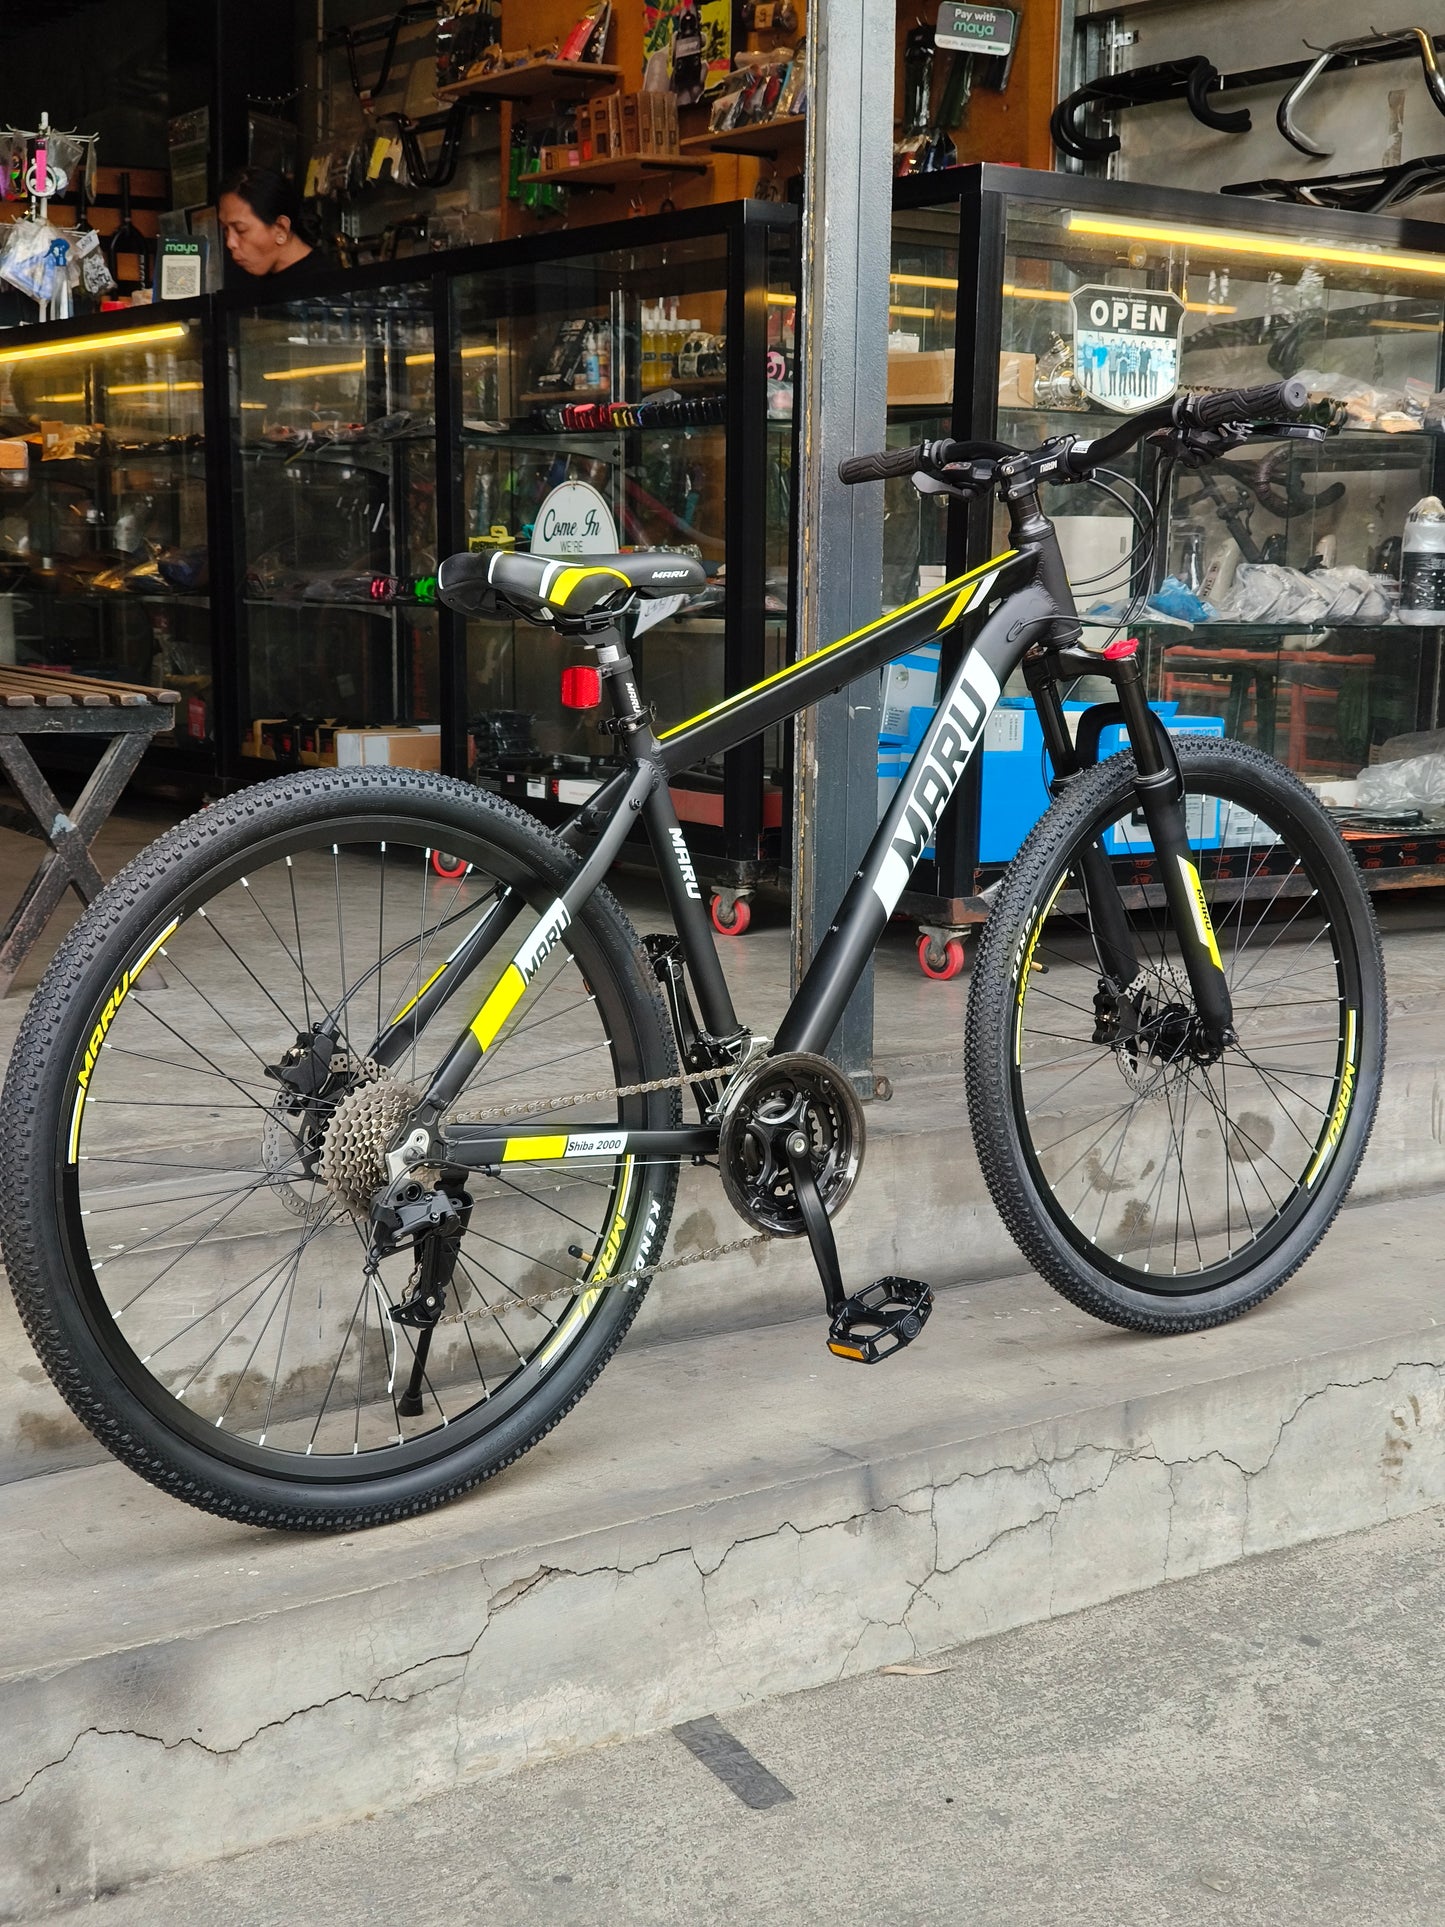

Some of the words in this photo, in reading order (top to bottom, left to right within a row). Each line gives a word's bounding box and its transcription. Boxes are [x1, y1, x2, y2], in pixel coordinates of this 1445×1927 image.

[953, 21, 995, 37] maya
[955, 8, 972, 21] Pay
[974, 12, 996, 22] with
[165, 243, 199, 254] maya
[1090, 300, 1168, 332] OPEN
[543, 508, 578, 542] Come
[581, 508, 602, 537] In
[560, 540, 584, 553] WE'RE
[651, 569, 690, 579] MARU
[625, 682, 641, 713] MARU
[891, 678, 987, 875] MARU
[668, 827, 702, 900] MARU
[1196, 888, 1212, 931] MARU
[524, 909, 569, 982] MARU
[77, 970, 130, 1089] MARU
[1329, 1060, 1356, 1147] MARU
[568, 1140, 595, 1152] Shiba
[596, 1139, 622, 1150] 2000
[581, 1213, 627, 1319] MARU
